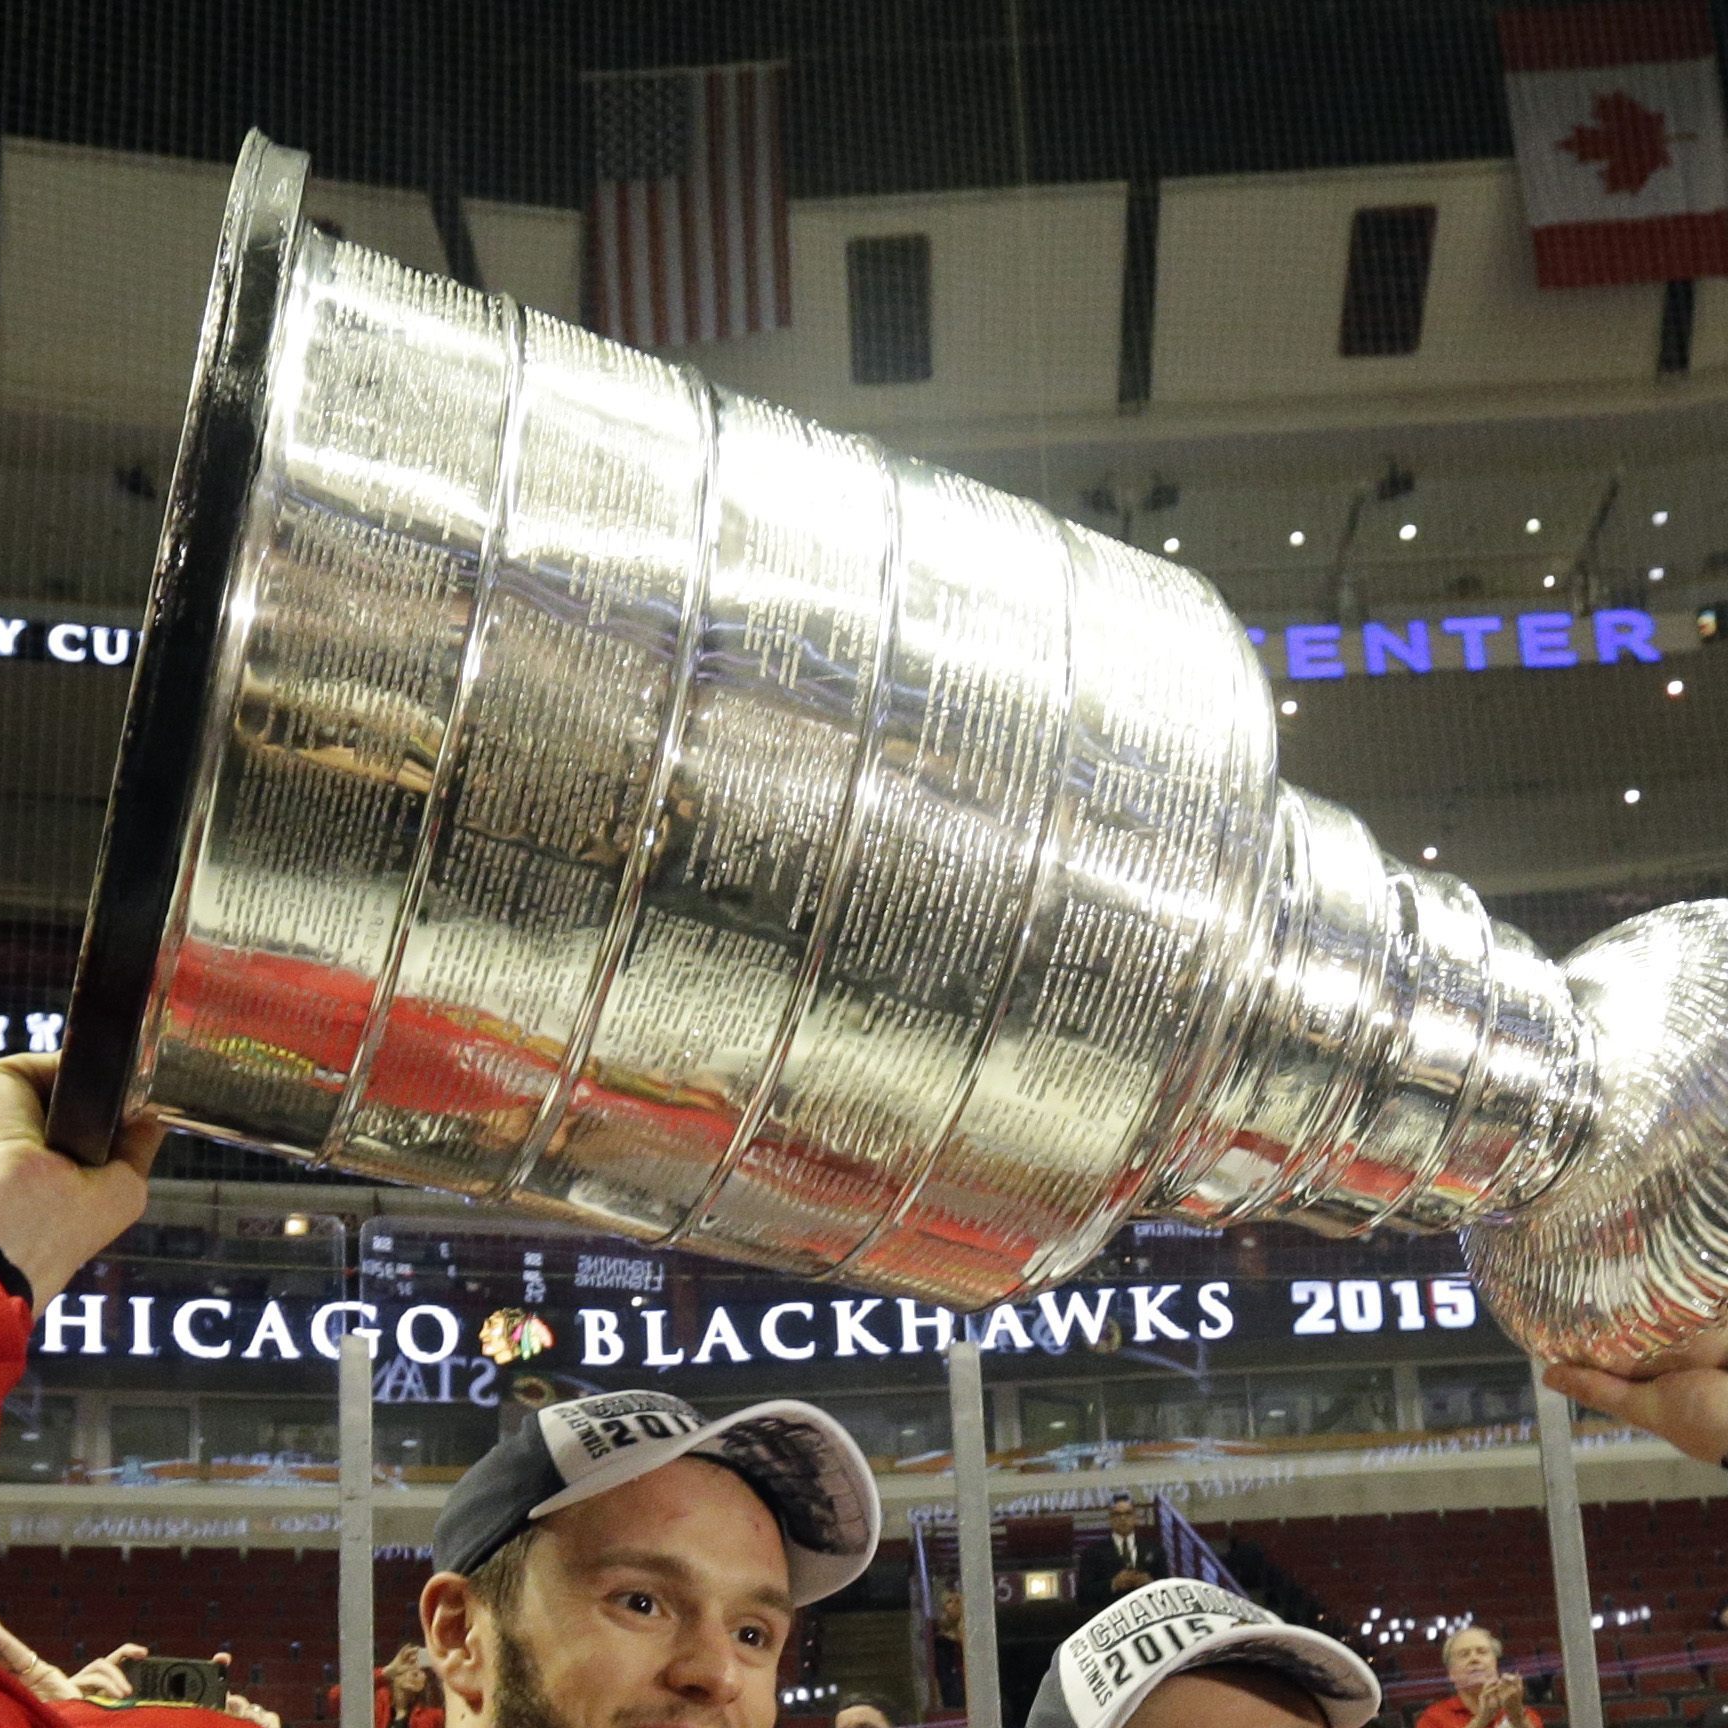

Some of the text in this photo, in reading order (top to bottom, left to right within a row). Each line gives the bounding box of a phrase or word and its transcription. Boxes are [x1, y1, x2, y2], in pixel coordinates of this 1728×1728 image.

[46, 622, 142, 667] CU
[1246, 609, 1662, 680] ENTER
[39, 1278, 1479, 1367] HICAGO BLACKHAWKS 2015
[1078, 1653, 1114, 1708] STANLEY
[1104, 1617, 1214, 1687] 2015
